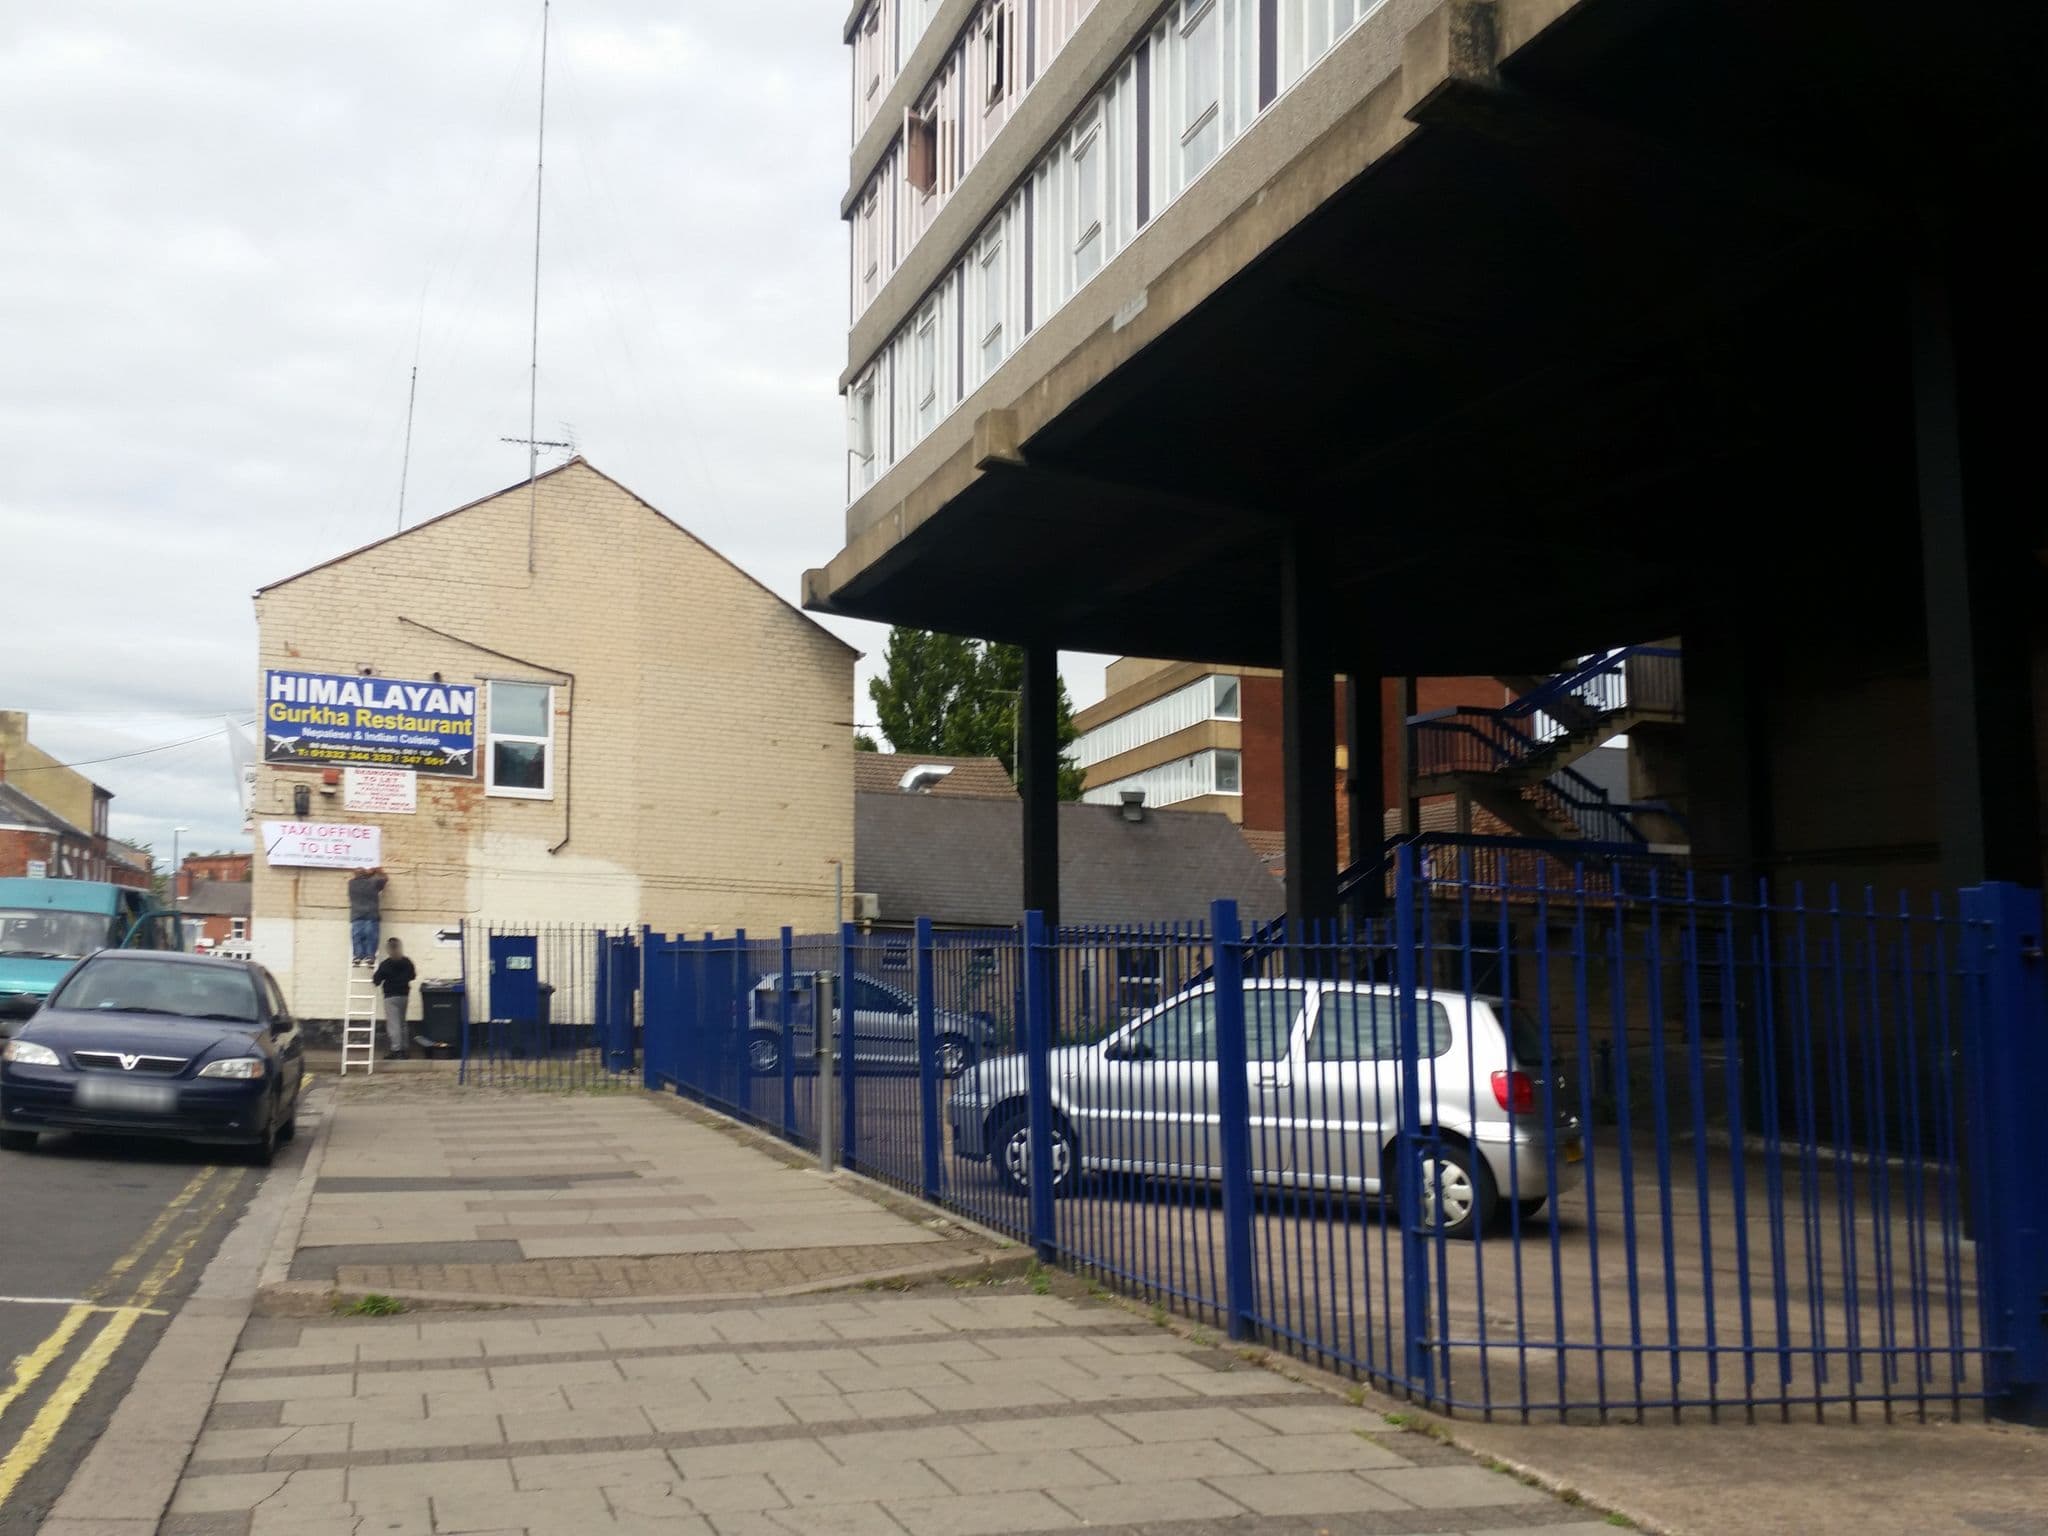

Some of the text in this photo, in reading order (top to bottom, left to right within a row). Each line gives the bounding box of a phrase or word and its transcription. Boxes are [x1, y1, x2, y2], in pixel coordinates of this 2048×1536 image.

[270, 675, 474, 715] HIMALAYAN
[269, 702, 473, 736] Gurkha Restaurant
[302, 727, 440, 745] Nepalese & Indian Cuisine
[280, 824, 372, 840] TAXI OFFICE
[299, 842, 351, 855] TO LET
